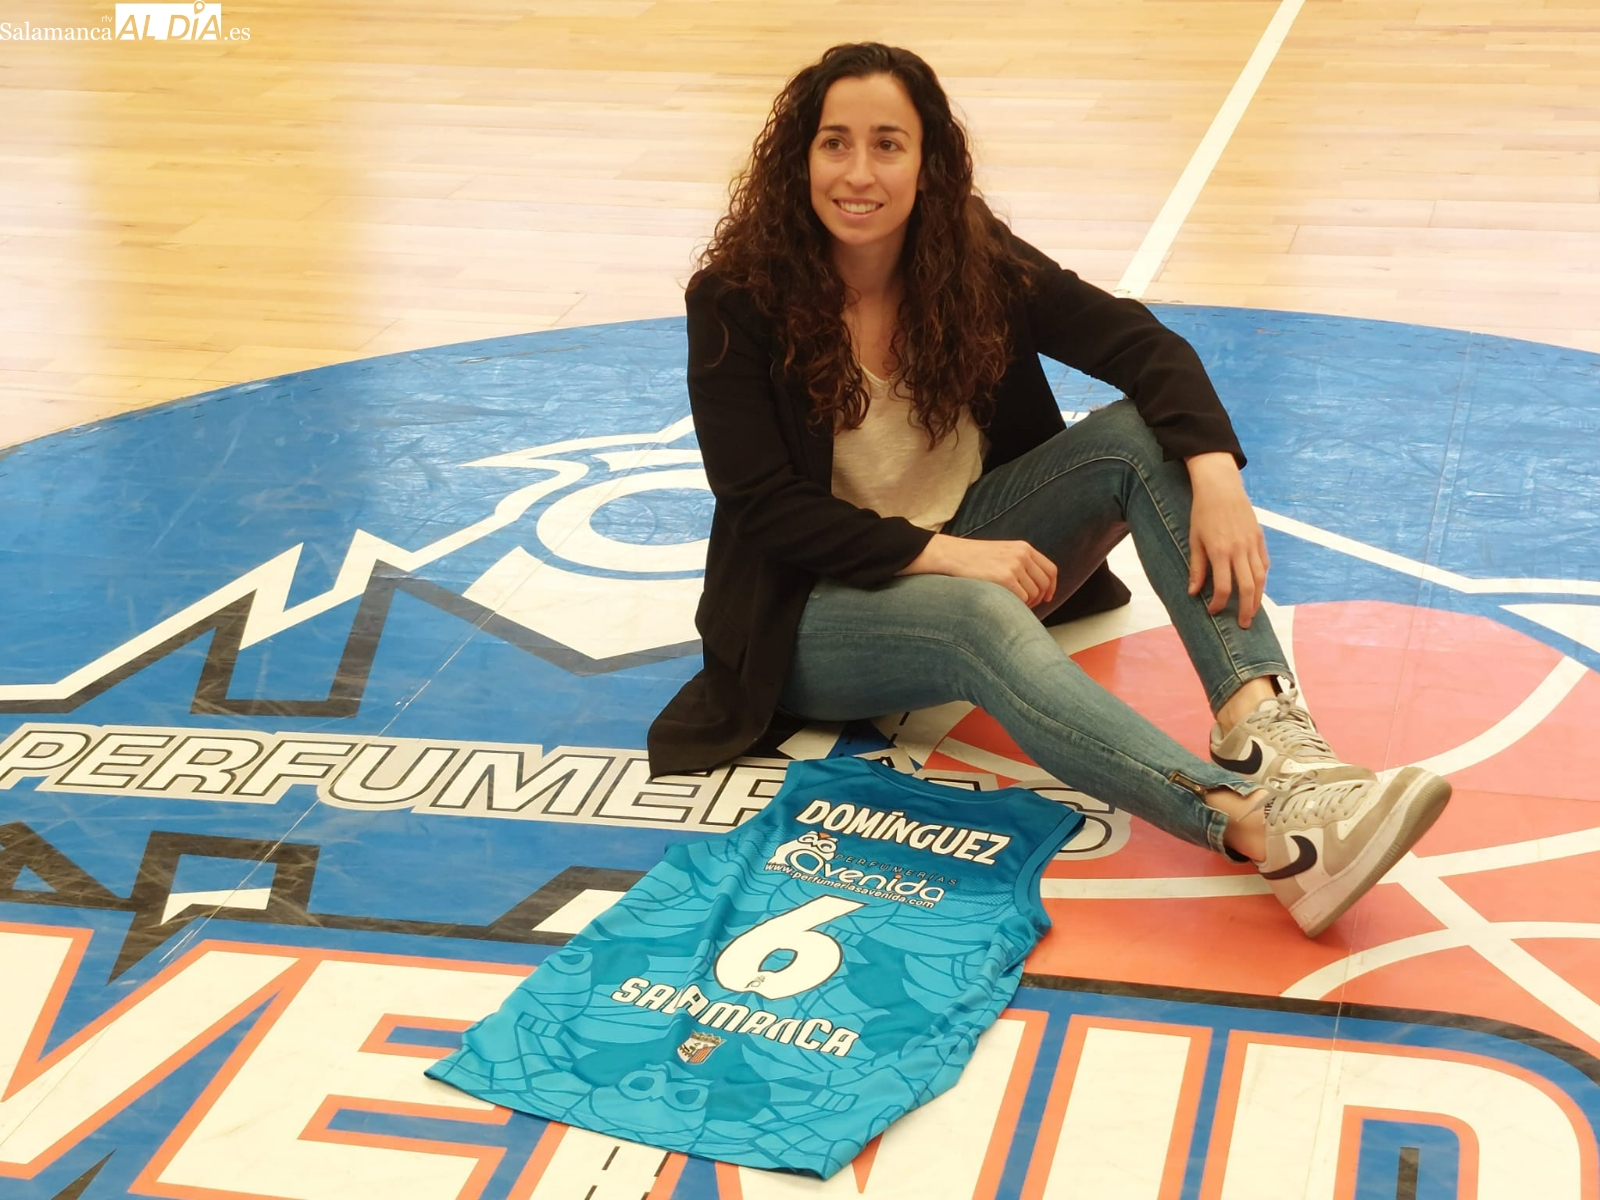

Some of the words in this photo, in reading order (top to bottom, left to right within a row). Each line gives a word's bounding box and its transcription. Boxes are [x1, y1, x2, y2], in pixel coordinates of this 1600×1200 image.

[796, 799, 1012, 865] DOMÍNGUEZ
[834, 854, 958, 886] PERFUMERÍAS
[713, 894, 869, 1001] 6
[610, 977, 861, 1057] SALAMANCA
